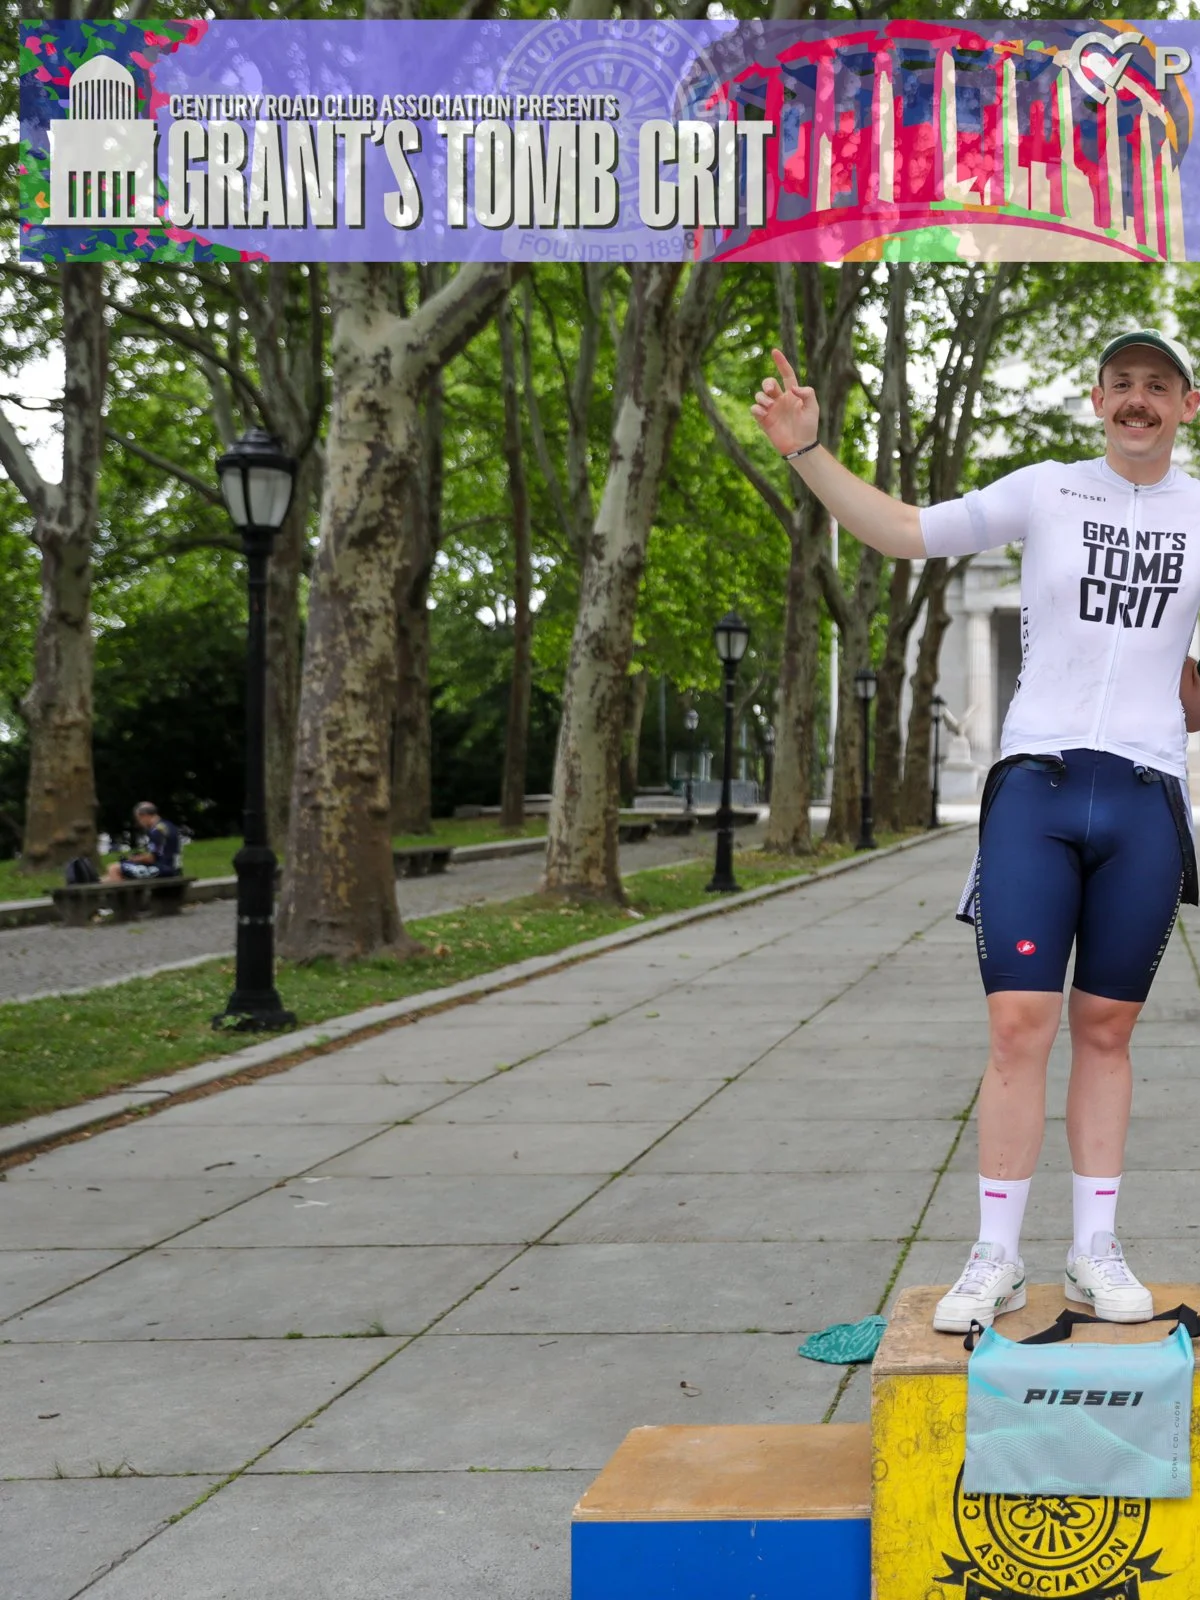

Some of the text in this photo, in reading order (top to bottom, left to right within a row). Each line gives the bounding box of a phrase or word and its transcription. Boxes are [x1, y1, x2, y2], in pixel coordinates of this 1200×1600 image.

[1071, 491, 1106, 503] PISSEI
[1083, 520, 1187, 551] GRANT'S
[1082, 541, 1184, 584] TOMB
[1079, 577, 1178, 629] CRIT
[975, 892, 988, 960] DETERMINED
[1149, 961, 1159, 973] TO
[1023, 1388, 1144, 1407] PISSEI
[974, 1537, 1129, 1593] ASSOCIATION
